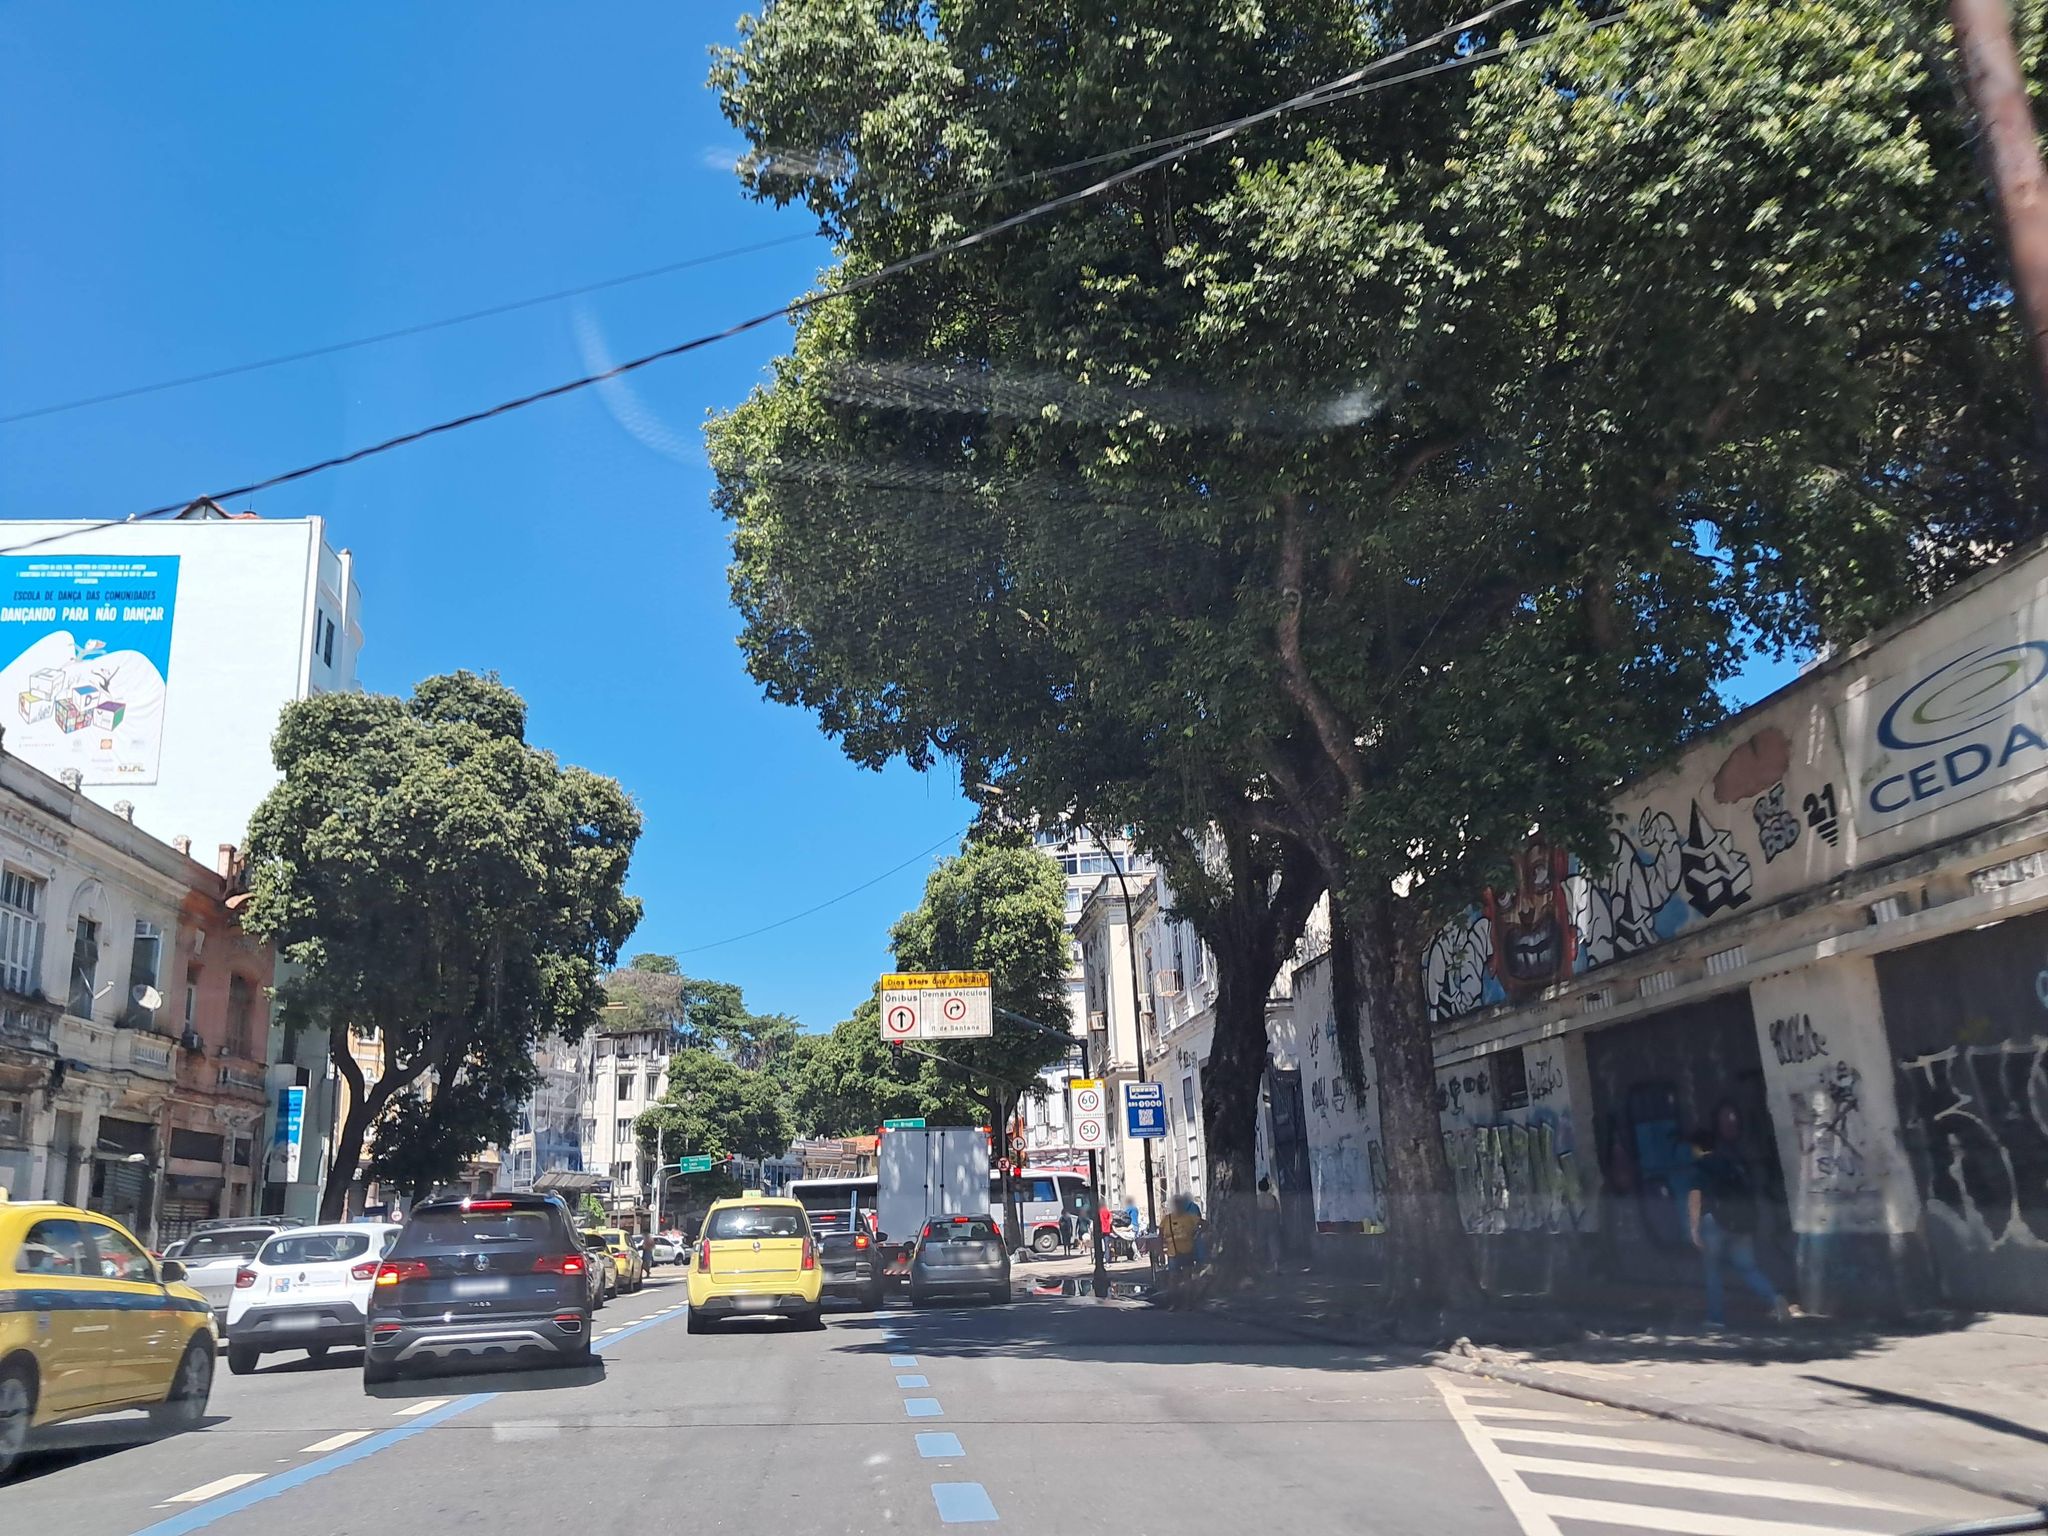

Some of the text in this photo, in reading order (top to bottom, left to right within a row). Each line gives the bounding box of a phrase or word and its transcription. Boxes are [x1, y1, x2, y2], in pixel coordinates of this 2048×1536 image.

[14, 590, 157, 603] ESCOLA DE DANÇA DAS COMUNIDADES
[0, 602, 165, 624] DANÇANDO PARA NÃO DANÇAR
[1802, 782, 1838, 828] 21
[884, 993, 918, 1003] Ônibus
[1082, 1095, 1095, 1104] 60
[1083, 1125, 1097, 1134] 50
